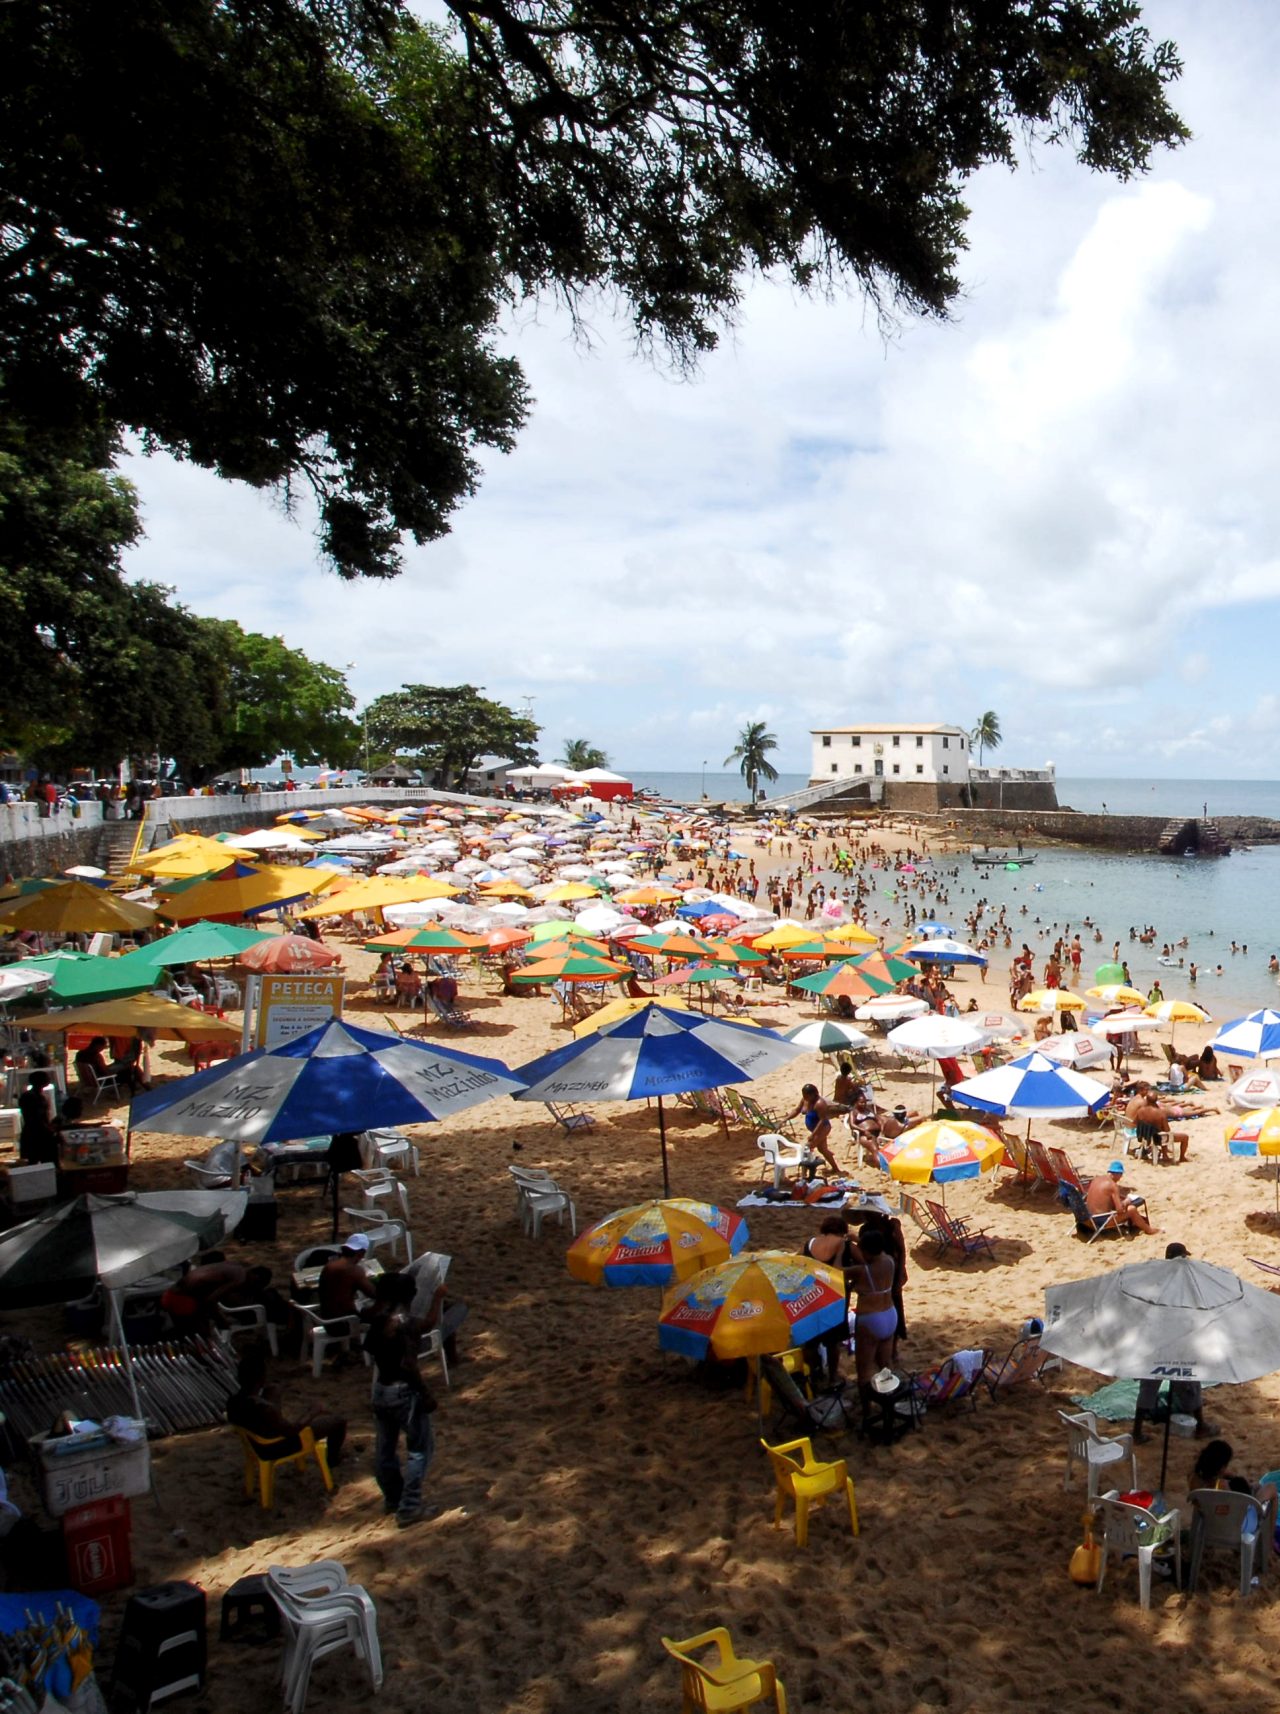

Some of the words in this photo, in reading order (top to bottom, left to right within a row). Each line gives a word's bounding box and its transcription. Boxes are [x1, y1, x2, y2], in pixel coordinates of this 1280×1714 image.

[271, 982, 334, 994] PETECA
[415, 1063, 455, 1082] MZ
[223, 1085, 274, 1100] MZ
[424, 1070, 499, 1102] Mazinho
